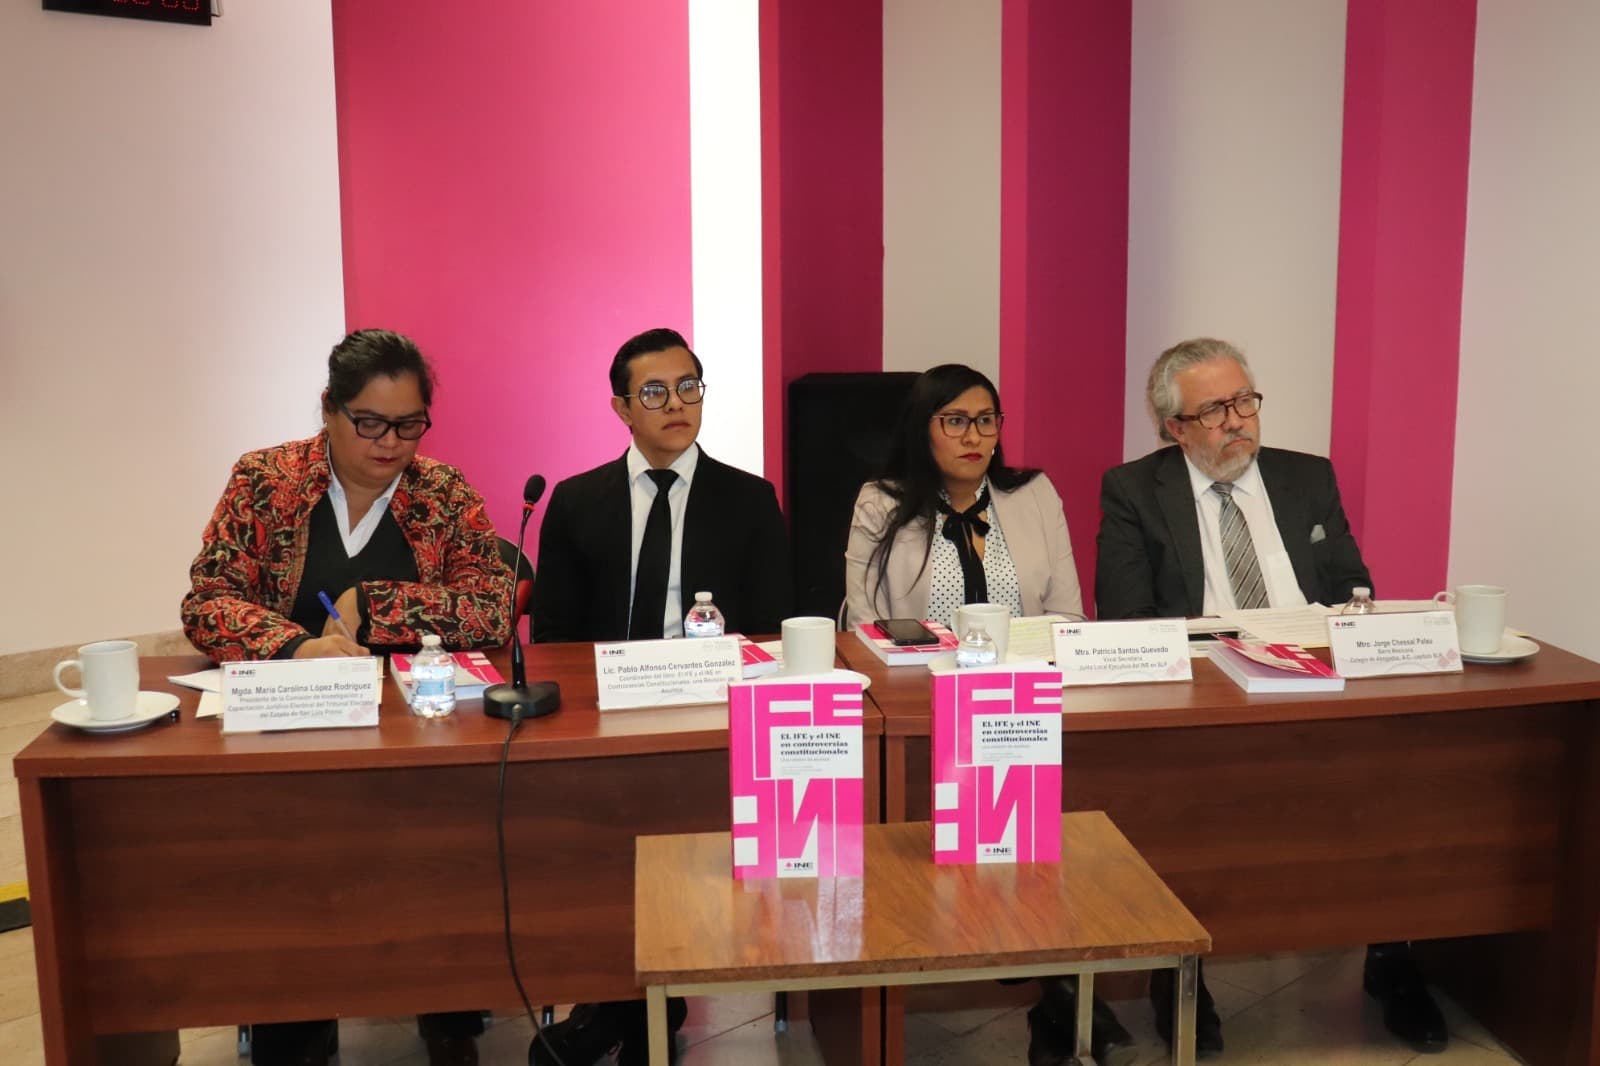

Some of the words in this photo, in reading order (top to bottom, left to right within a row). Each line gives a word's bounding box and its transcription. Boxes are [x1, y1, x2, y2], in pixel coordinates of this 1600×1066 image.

[1374, 640, 1391, 648] Jorge
[1141, 646, 1169, 654] Quevedo
[618, 665, 638, 673] Pablo
[639, 663, 667, 672] Alfonso
[668, 661, 703, 670] Cervantes
[278, 683, 308, 693] Carolina
[310, 681, 332, 693] López
[995, 720, 1009, 728] IFE
[1010, 721, 1015, 729] y
[816, 732, 824, 740] el
[825, 732, 841, 740] INE
[982, 735, 1048, 743] constitucionales
[792, 740, 849, 748] controversias
[780, 748, 849, 756] constitucionales
